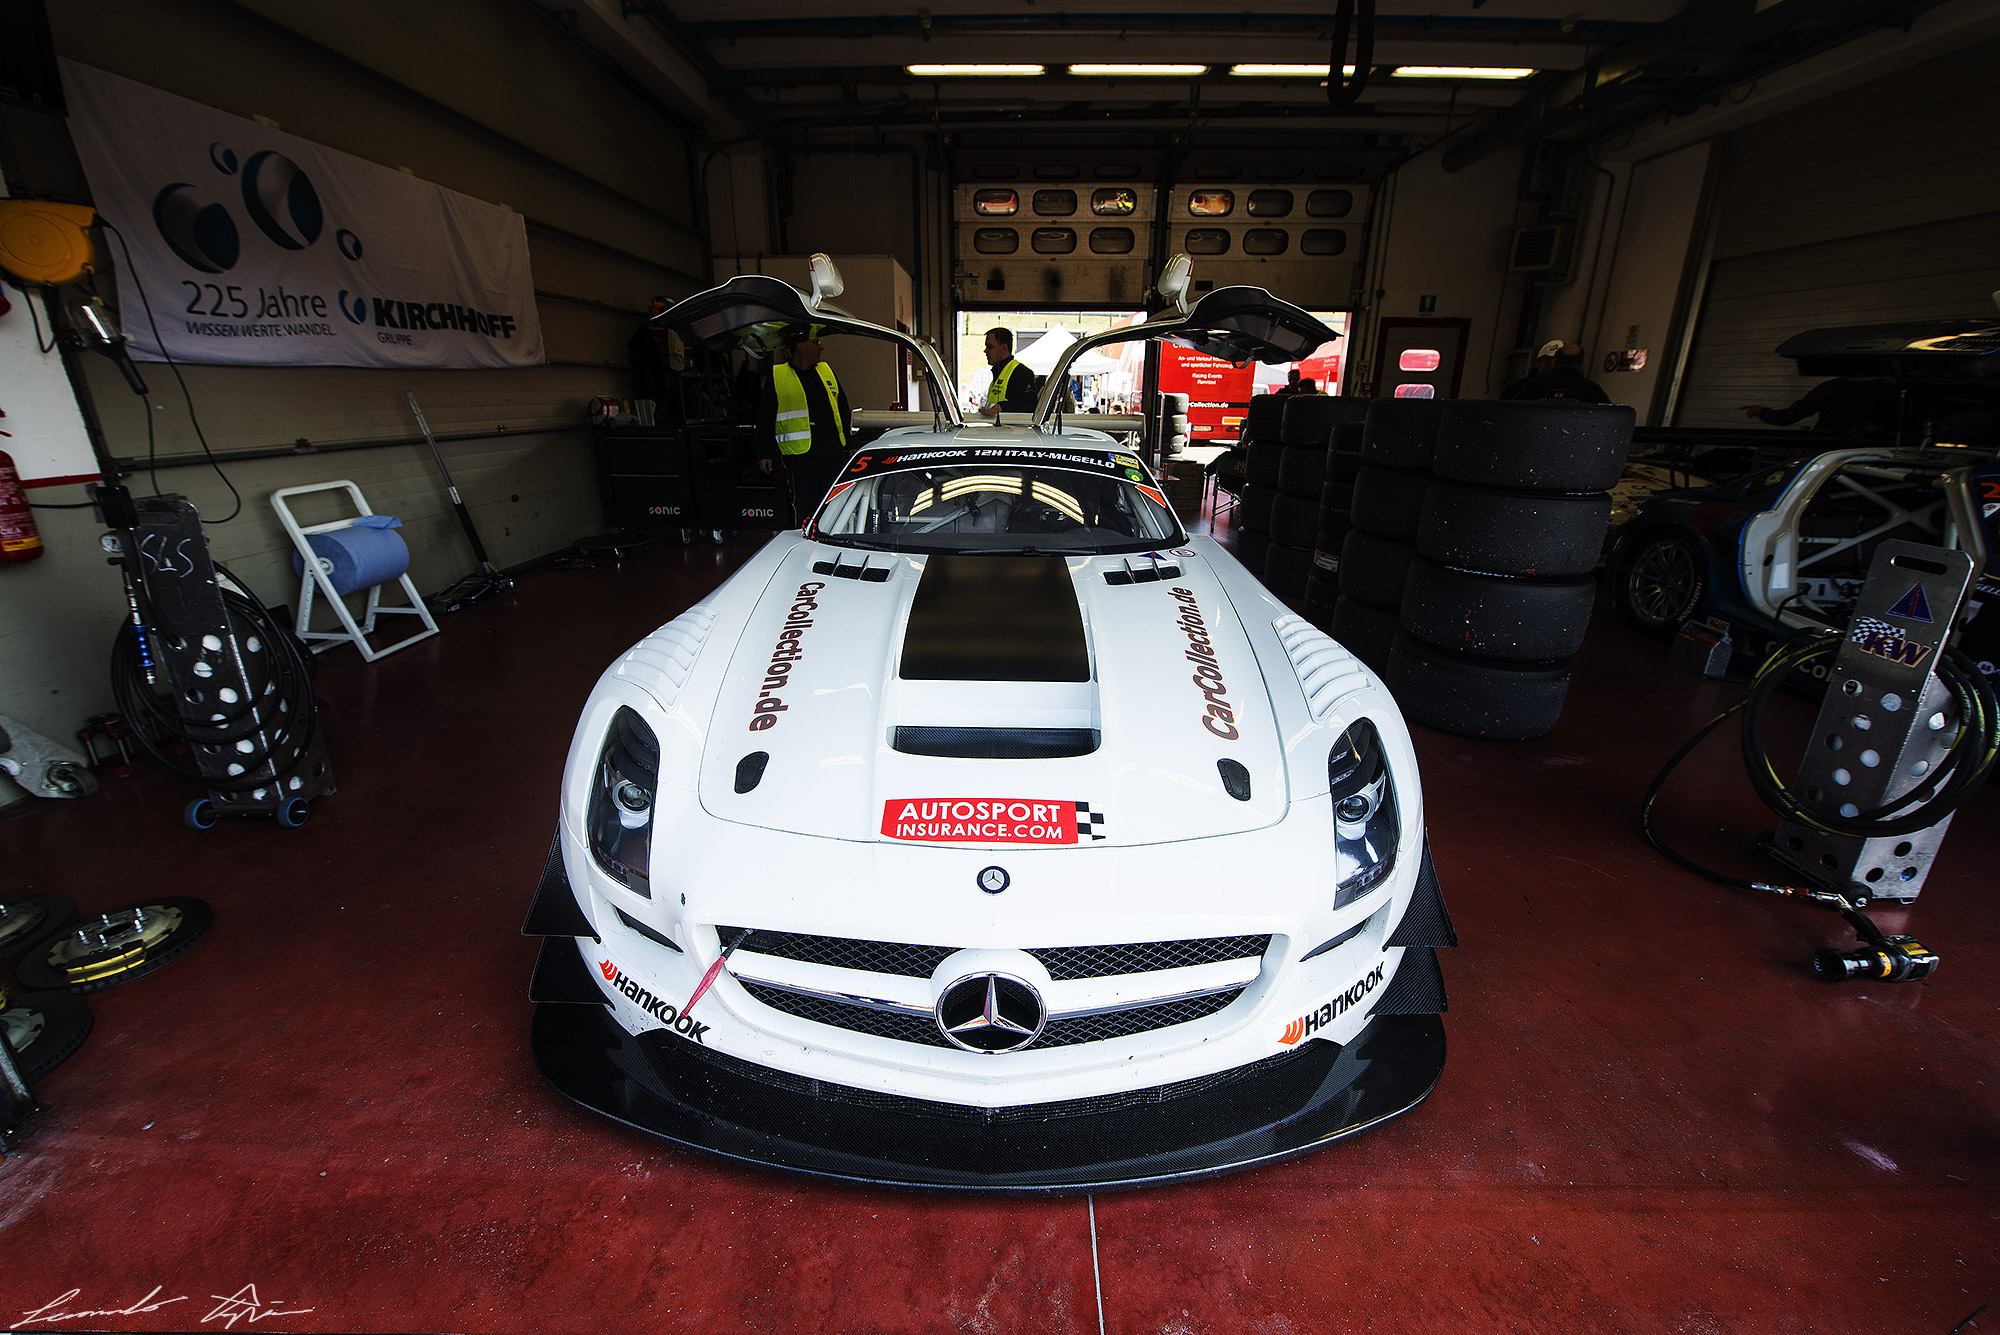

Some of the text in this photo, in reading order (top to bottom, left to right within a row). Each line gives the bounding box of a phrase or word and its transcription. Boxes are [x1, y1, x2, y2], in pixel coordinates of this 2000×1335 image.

[182, 280, 328, 318] 225 Jahre
[372, 297, 517, 339] KIRCHHOFF
[376, 331, 412, 346] GRUPPE
[850, 456, 873, 473] 5
[974, 449, 1003, 457] 12H
[1004, 449, 1116, 469] ITALY-MUGELLO
[139, 532, 195, 579] SLS
[748, 581, 827, 732] CarCollection.de
[1166, 586, 1240, 741] CarCollection.de
[1860, 631, 1933, 668] KW
[897, 801, 1061, 823] AUTOSPORT
[896, 823, 1063, 840] INSURANCE.COM
